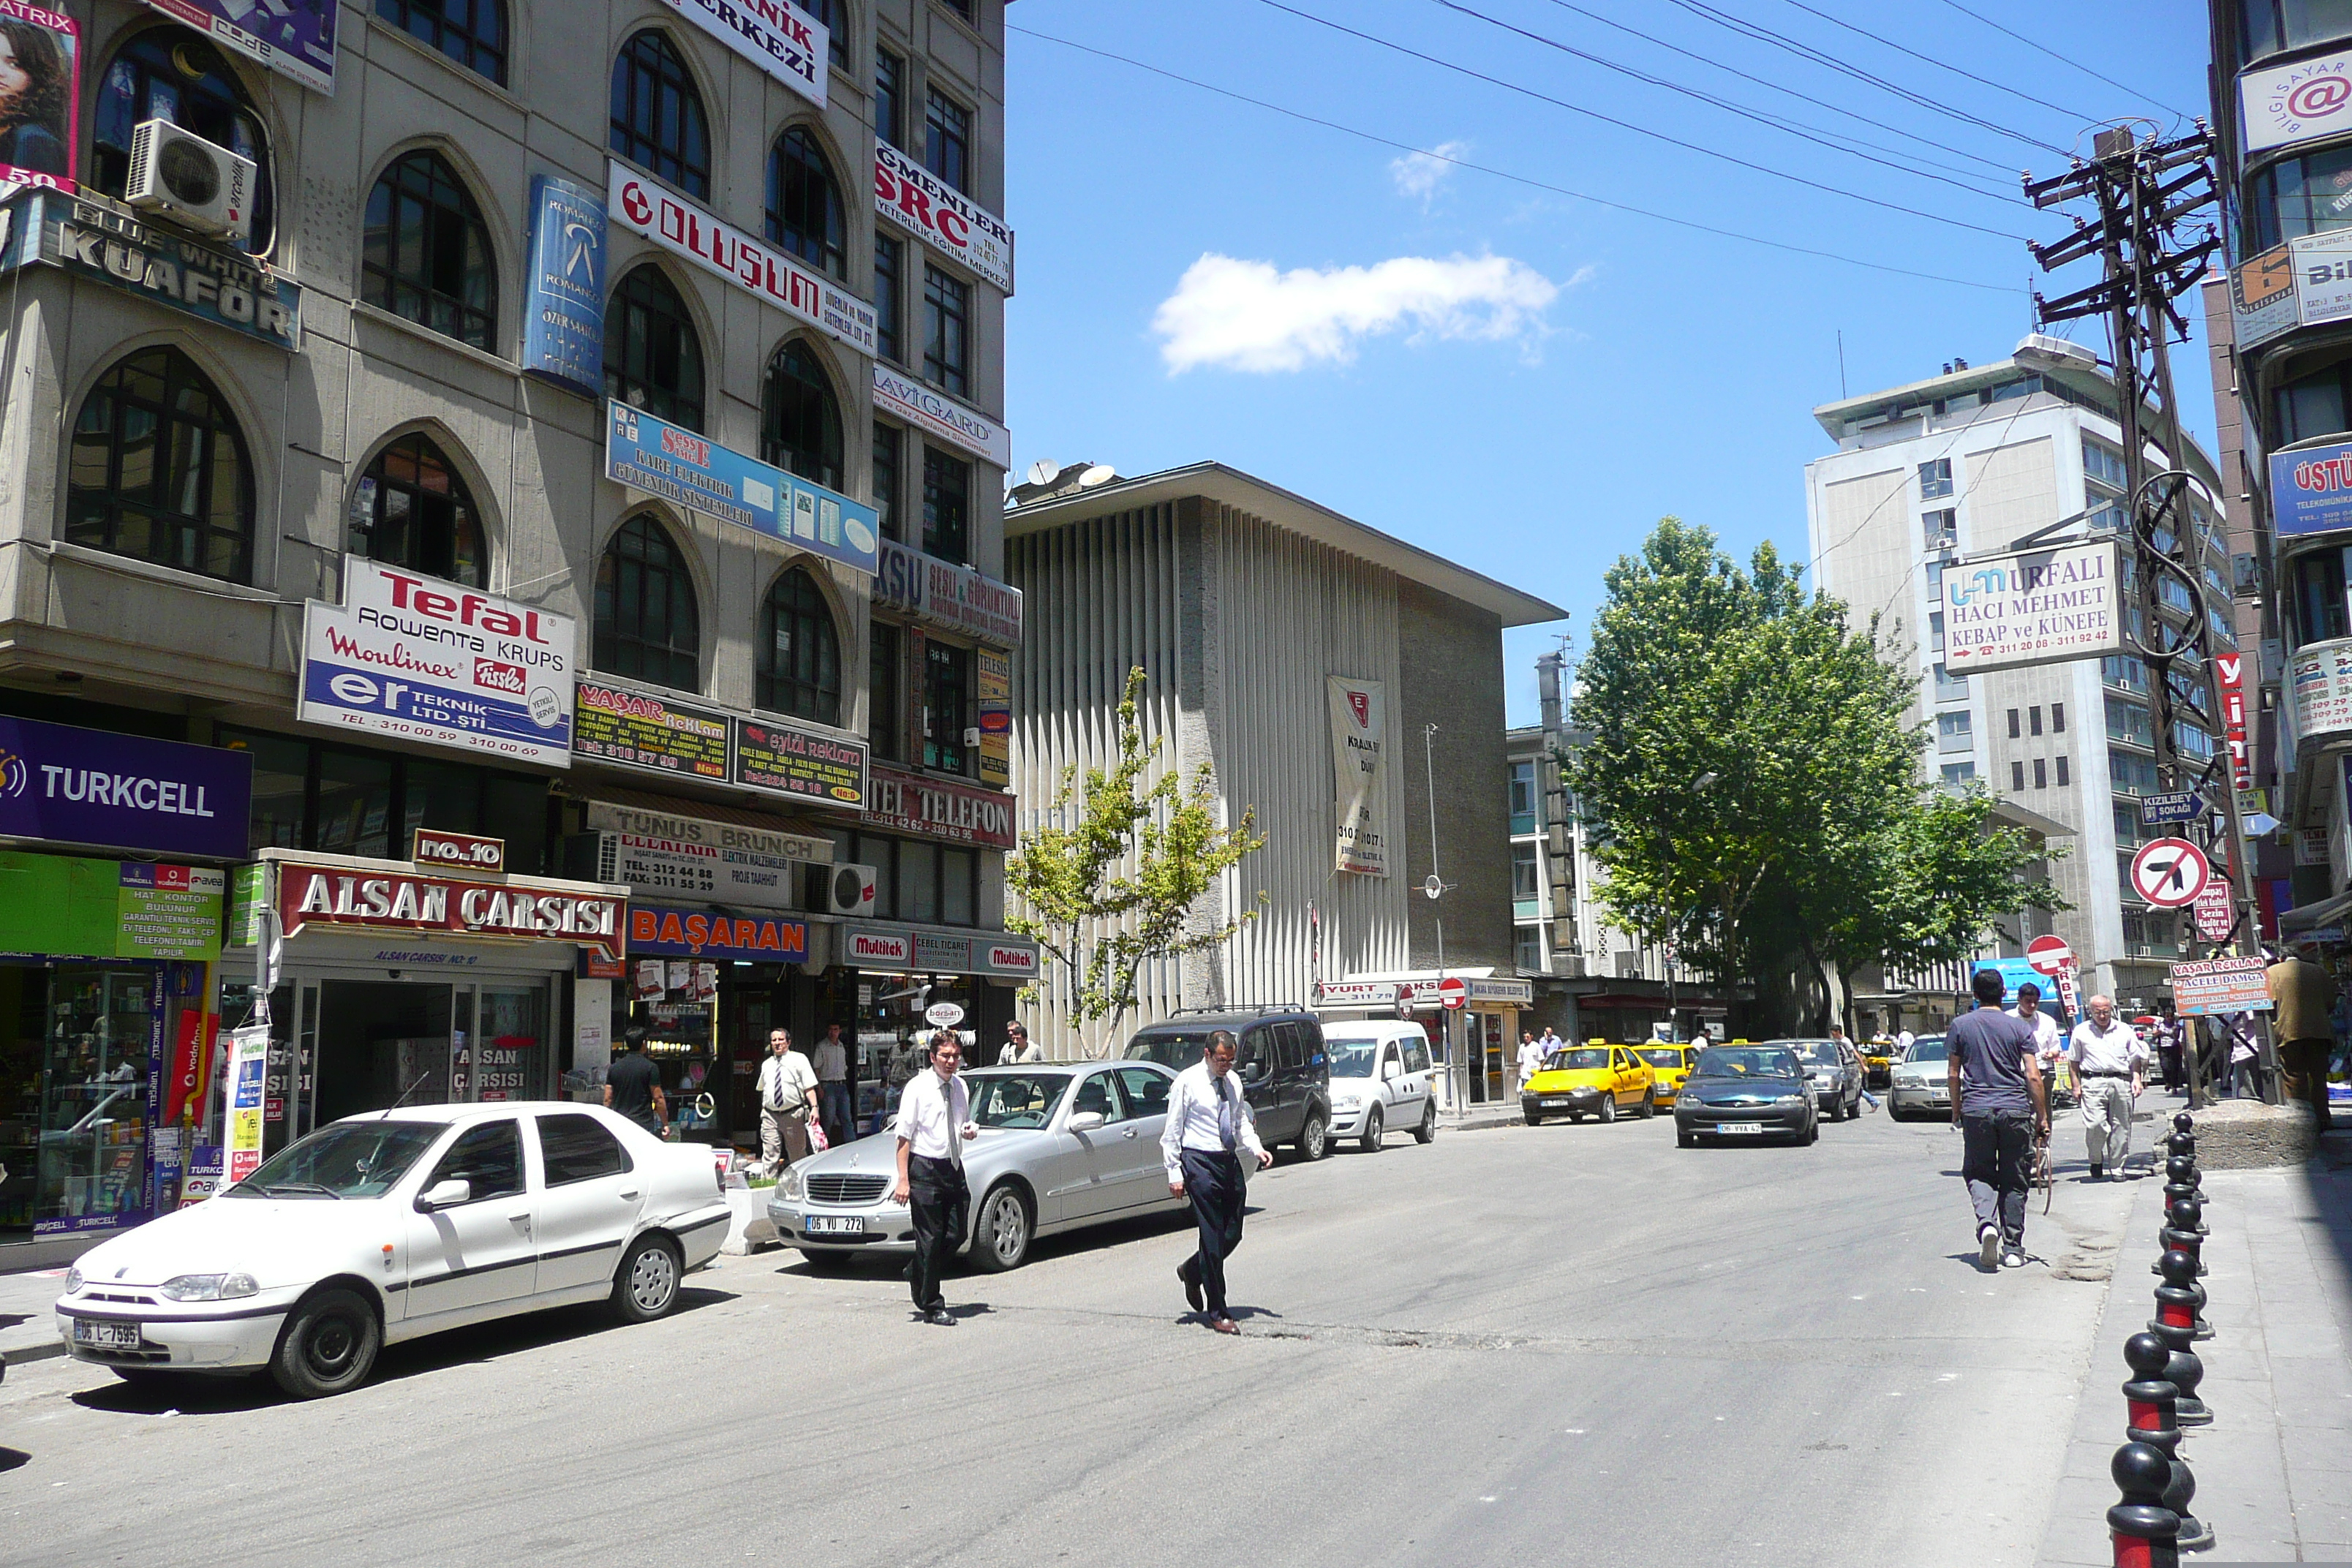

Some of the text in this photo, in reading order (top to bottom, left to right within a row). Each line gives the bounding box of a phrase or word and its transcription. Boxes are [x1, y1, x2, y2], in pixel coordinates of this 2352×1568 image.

[875, 162, 968, 248] SRC
[660, 198, 818, 317] OLUŞUM
[59, 221, 294, 338] KUAFÖR
[970, 258, 1009, 288] MERKEZİ
[883, 399, 991, 457] ve Gaz Algılama Sistemleri
[636, 448, 734, 500] KARE ELEKTRİK
[614, 461, 753, 527] GÜVENLİK SİSTEMLERİ
[2010, 556, 2105, 592] URFALI
[380, 570, 550, 645] Tefal
[1953, 587, 2105, 624] HACI MEHMET
[1952, 610, 2108, 647] KEBAP ve KÜNEFE
[1999, 630, 2108, 654] 311 20 08 311 92 42
[325, 626, 526, 693] Moulinex Fissler
[498, 640, 564, 671] KRUPS
[330, 673, 489, 716] er TEKNİK
[580, 685, 665, 721] YAŞAR
[532, 695, 557, 720] YETKİLİ SERVİS
[380, 720, 411, 731] 310
[415, 726, 432, 736] 00
[438, 731, 457, 741] 59
[469, 736, 496, 748] 310
[500, 742, 517, 753] 00
[521, 746, 539, 756] 69
[606, 744, 634, 760] 310
[638, 750, 656, 764] 57
[660, 756, 678, 769] 99
[41, 765, 214, 818] TURKCELL
[2144, 794, 2192, 806] KIZILBEY
[917, 786, 1009, 836] TELEFON
[2159, 804, 2191, 815] SOKAĞI
[617, 812, 813, 858] TUNUS BRUNCH
[897, 817, 909, 829] 42
[911, 820, 923, 831] 62
[931, 823, 947, 834] 310
[202, 878, 223, 886] avea
[623, 872, 714, 891] FAX: 311 55 29
[625, 860, 649, 871] TEL:
[653, 864, 676, 875] 312
[679, 867, 693, 877] 44
[698, 870, 712, 878] 88
[732, 870, 750, 883] PROJE
[134, 891, 208, 903] HAT KONTÖR
[146, 903, 196, 913] BULUNUR
[298, 873, 448, 923] ALSAN
[2201, 908, 2224, 917] Sezin
[123, 924, 132, 932] EV
[135, 924, 172, 934] TELEFONU
[202, 927, 216, 936] CEP
[134, 935, 176, 945] TELEFONU
[631, 910, 804, 954] BAŞARAN
[856, 937, 902, 957] Multitek
[993, 949, 1030, 967] Multitek
[2173, 957, 2264, 976] YAŞAR REKLAM
[1327, 985, 1377, 993] YURT
[2184, 973, 2265, 988] ACELE DAMGA
[459, 1049, 516, 1064] ASAN
[811, 1218, 861, 1231] 06 VU 272
[81, 1322, 135, 1343] 06 L 7595
